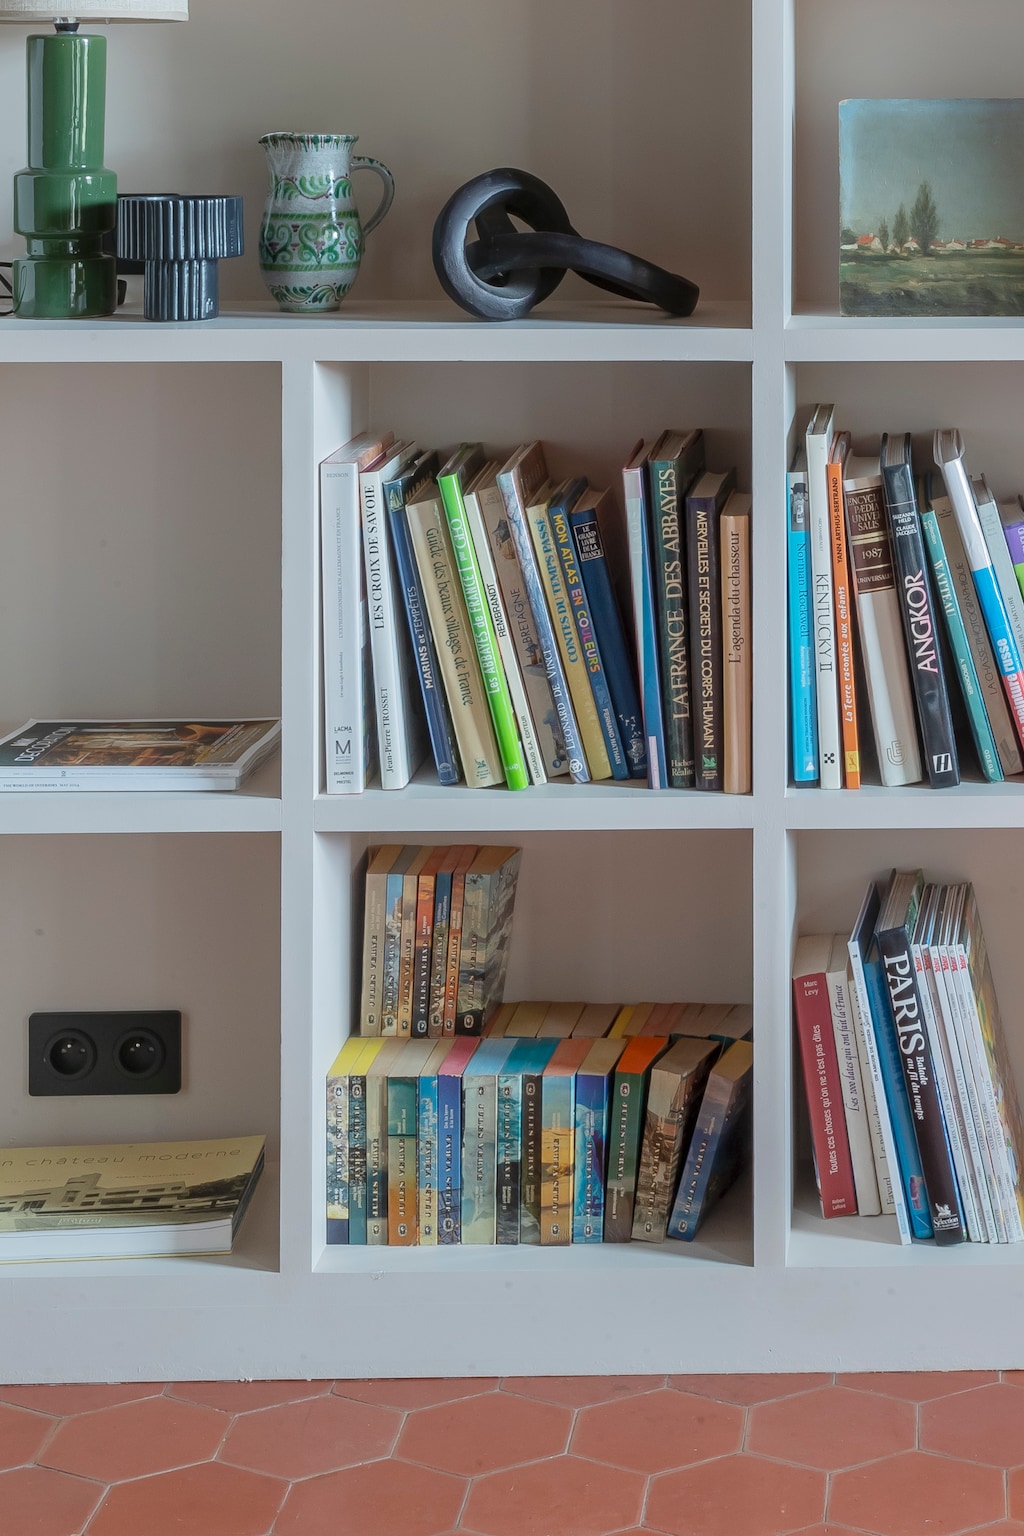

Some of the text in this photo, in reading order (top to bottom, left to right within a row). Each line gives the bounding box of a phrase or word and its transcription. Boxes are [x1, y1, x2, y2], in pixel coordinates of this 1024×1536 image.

[578, 530, 598, 540] GRAND
[580, 538, 597, 547] LIVRE
[831, 476, 842, 542] ARTHUS-BERTRAND
[892, 511, 917, 520] SUZANNE
[895, 528, 918, 539] JACQUES
[896, 523, 916, 533] CLAUDE
[898, 516, 912, 524] HELD
[363, 485, 385, 630] LES CROIX DE SAVOIE
[534, 516, 579, 663] CONTES DU TEMPS PASSÉ
[581, 550, 601, 560] FRANCE
[796, 543, 810, 638] Norman Rockwell
[861, 547, 884, 560] 1987
[933, 559, 957, 617] WATTEAU
[426, 527, 474, 706] Guide des beaux villages de France
[486, 583, 507, 638] REMBRANDT
[553, 514, 602, 674] MON ATLAS EN COULEURS
[658, 468, 690, 720] LA FRANCE DES ABBAYES
[696, 509, 715, 749] MERVEILLES ET SECRETS DU CORPS HUMAIN
[727, 530, 745, 665] L'agenda du chasseur
[815, 573, 833, 658] KENTUCKY
[904, 569, 939, 675] ANGKOR
[956, 562, 998, 696] LA CHASSE PHOTOGRAPHIQUE
[1007, 596, 1020, 623] NATURE
[406, 585, 435, 690] MARINS et TEMPÊTES
[462, 573, 500, 694] Les ABBAYES de FRANCE
[837, 585, 854, 723] La Terre racontée aux enfants
[996, 637, 1016, 673] russe
[380, 687, 394, 774] Jean-Pierre TROSSET
[542, 649, 576, 750] LEONARD DE VINCI
[983, 749, 996, 775] ODEGE
[419, 940, 429, 1014] JULES VERNE
[803, 979, 818, 988] Marc
[804, 988, 819, 997] Levy
[883, 950, 926, 1056] PARIS
[812, 1024, 839, 1175] Toutes ces choses qu'on ne s'est pas dites
[906, 1057, 925, 1121] au fil du temps
[915, 1056, 929, 1086] Balade
[25, 1149, 242, 1167] château moderne
[398, 1138, 406, 1217] JULES VERNE
[527, 1100, 536, 1178] JULES VERNE
[551, 1138, 560, 1215] JULES VERNE
[616, 1101, 628, 1181] JULES VERNE
